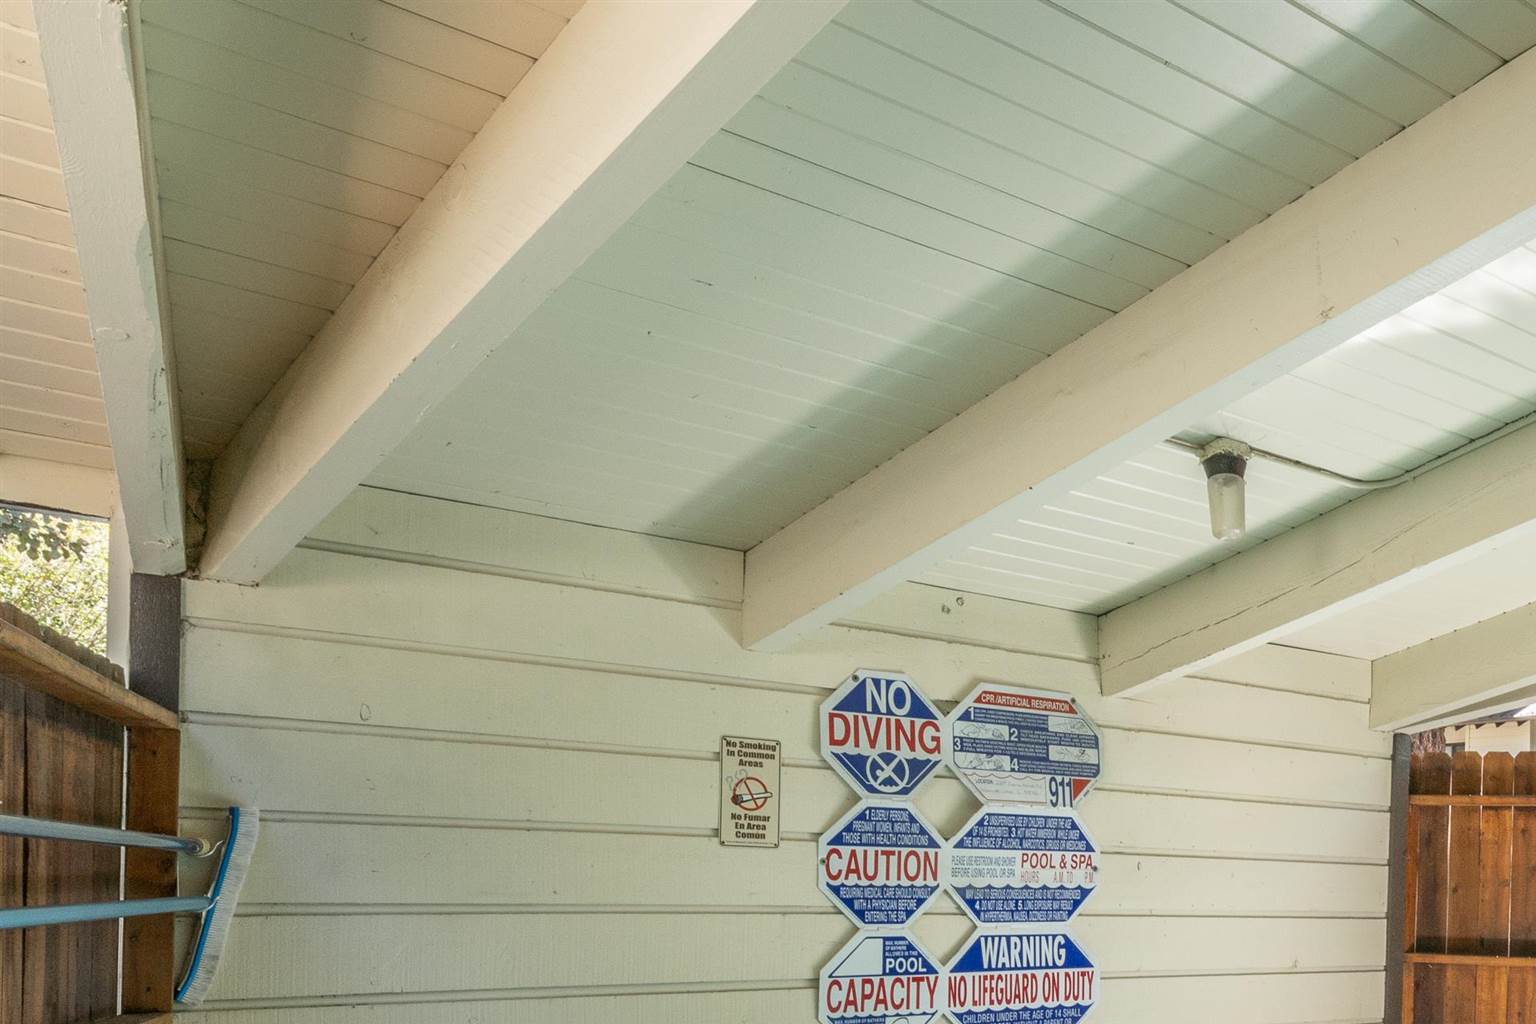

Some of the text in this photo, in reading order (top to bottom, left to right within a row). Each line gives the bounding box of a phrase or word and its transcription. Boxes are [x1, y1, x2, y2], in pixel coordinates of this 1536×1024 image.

[866, 678, 911, 716] NO
[981, 693, 995, 703] CPR
[1032, 700, 1070, 712] RESPIRATION
[968, 707, 974, 720] 1
[829, 712, 941, 754] DIVING
[1010, 728, 1018, 740] 2
[726, 740, 776, 752] No Smoking
[954, 738, 961, 750] 3
[727, 749, 775, 760] In Common
[739, 759, 763, 768] Areas
[1011, 759, 1019, 771] 4
[1049, 776, 1072, 808] 911
[744, 814, 770, 822] Fumar
[866, 810, 869, 820] 1
[984, 816, 989, 826] 2
[853, 822, 875, 832] PREGNANT
[1011, 828, 1016, 837] 3
[843, 832, 928, 845] THOSE WITH HEALTH CONDITIONS
[964, 837, 972, 847] THE
[826, 848, 938, 882] CAUTION
[1021, 853, 1093, 869] POOL & SPA
[952, 868, 970, 877] BEFORE
[1021, 871, 1040, 883] HOURS
[854, 900, 917, 910] WITH A PHYSICIAN BEFORE
[975, 901, 979, 910] 4
[865, 911, 906, 922] ENTERING THE SPA
[980, 935, 1066, 969] WARNING
[886, 958, 927, 973] POOL
[826, 976, 939, 1013] CAPACITY
[948, 971, 1094, 1008] NO LIFEGUARD ON DUTY
[963, 1008, 1081, 1024] CHILDREN UNDER THE AGE OF 14 SHALL
